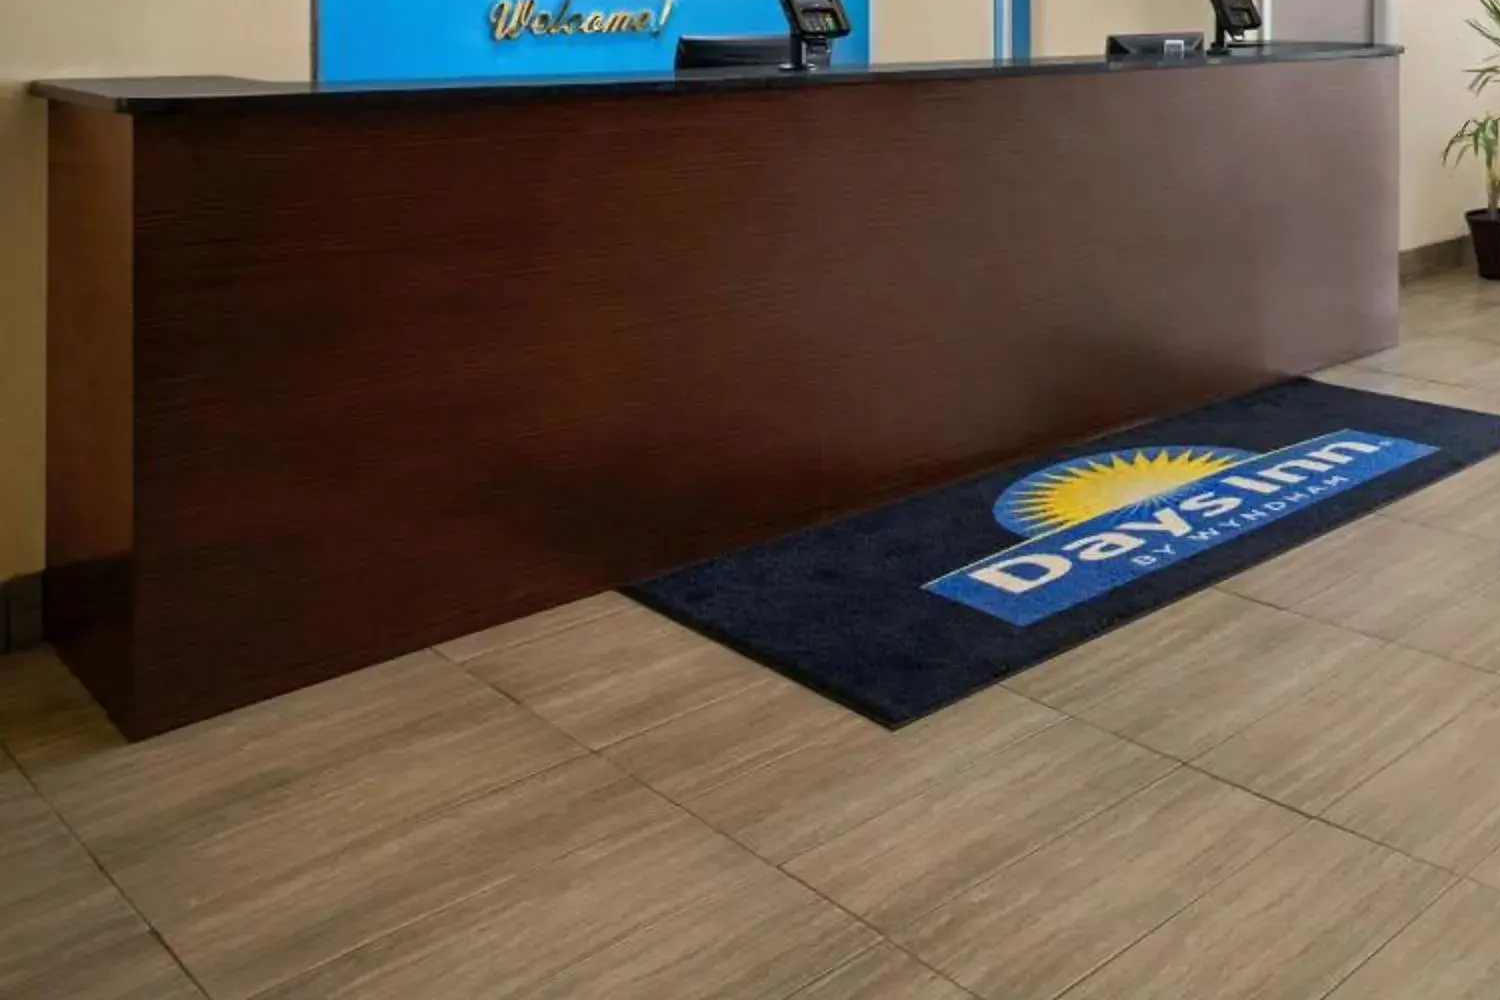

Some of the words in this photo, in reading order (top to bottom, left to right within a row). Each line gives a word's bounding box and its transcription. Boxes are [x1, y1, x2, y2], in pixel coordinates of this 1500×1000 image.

[967, 491, 1243, 594] Days
[1220, 441, 1381, 494] Inn
[1131, 543, 1176, 566] BY
[1188, 474, 1349, 541] WYNDHAM
